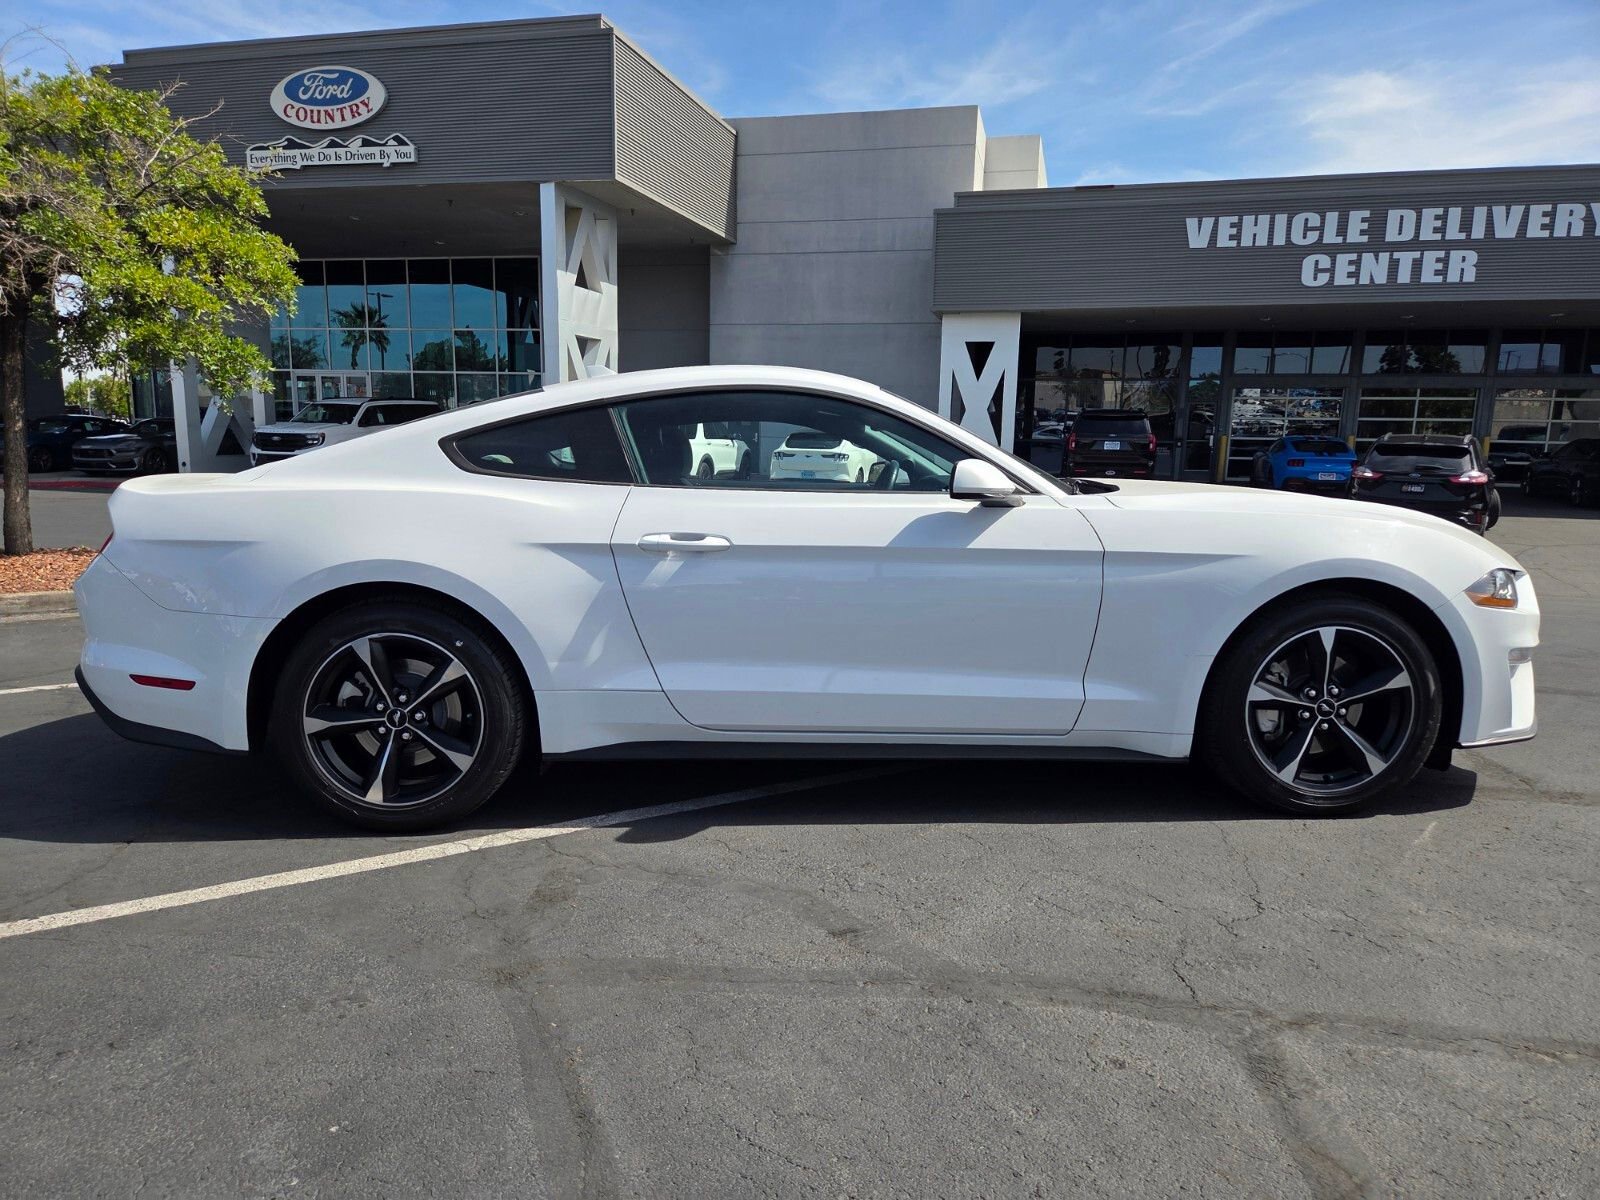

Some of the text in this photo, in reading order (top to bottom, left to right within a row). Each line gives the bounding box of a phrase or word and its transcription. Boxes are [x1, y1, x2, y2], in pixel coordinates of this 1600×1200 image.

[298, 72, 354, 100] Ford
[283, 97, 373, 124] COUNTRY
[300, 152, 315, 162] We
[318, 151, 332, 161] Do
[334, 151, 342, 161] Is
[345, 150, 376, 161] Driven
[379, 149, 391, 163] By
[394, 149, 412, 159] You
[1185, 210, 1370, 249] VEHICLE
[1301, 250, 1478, 287] CENTER
